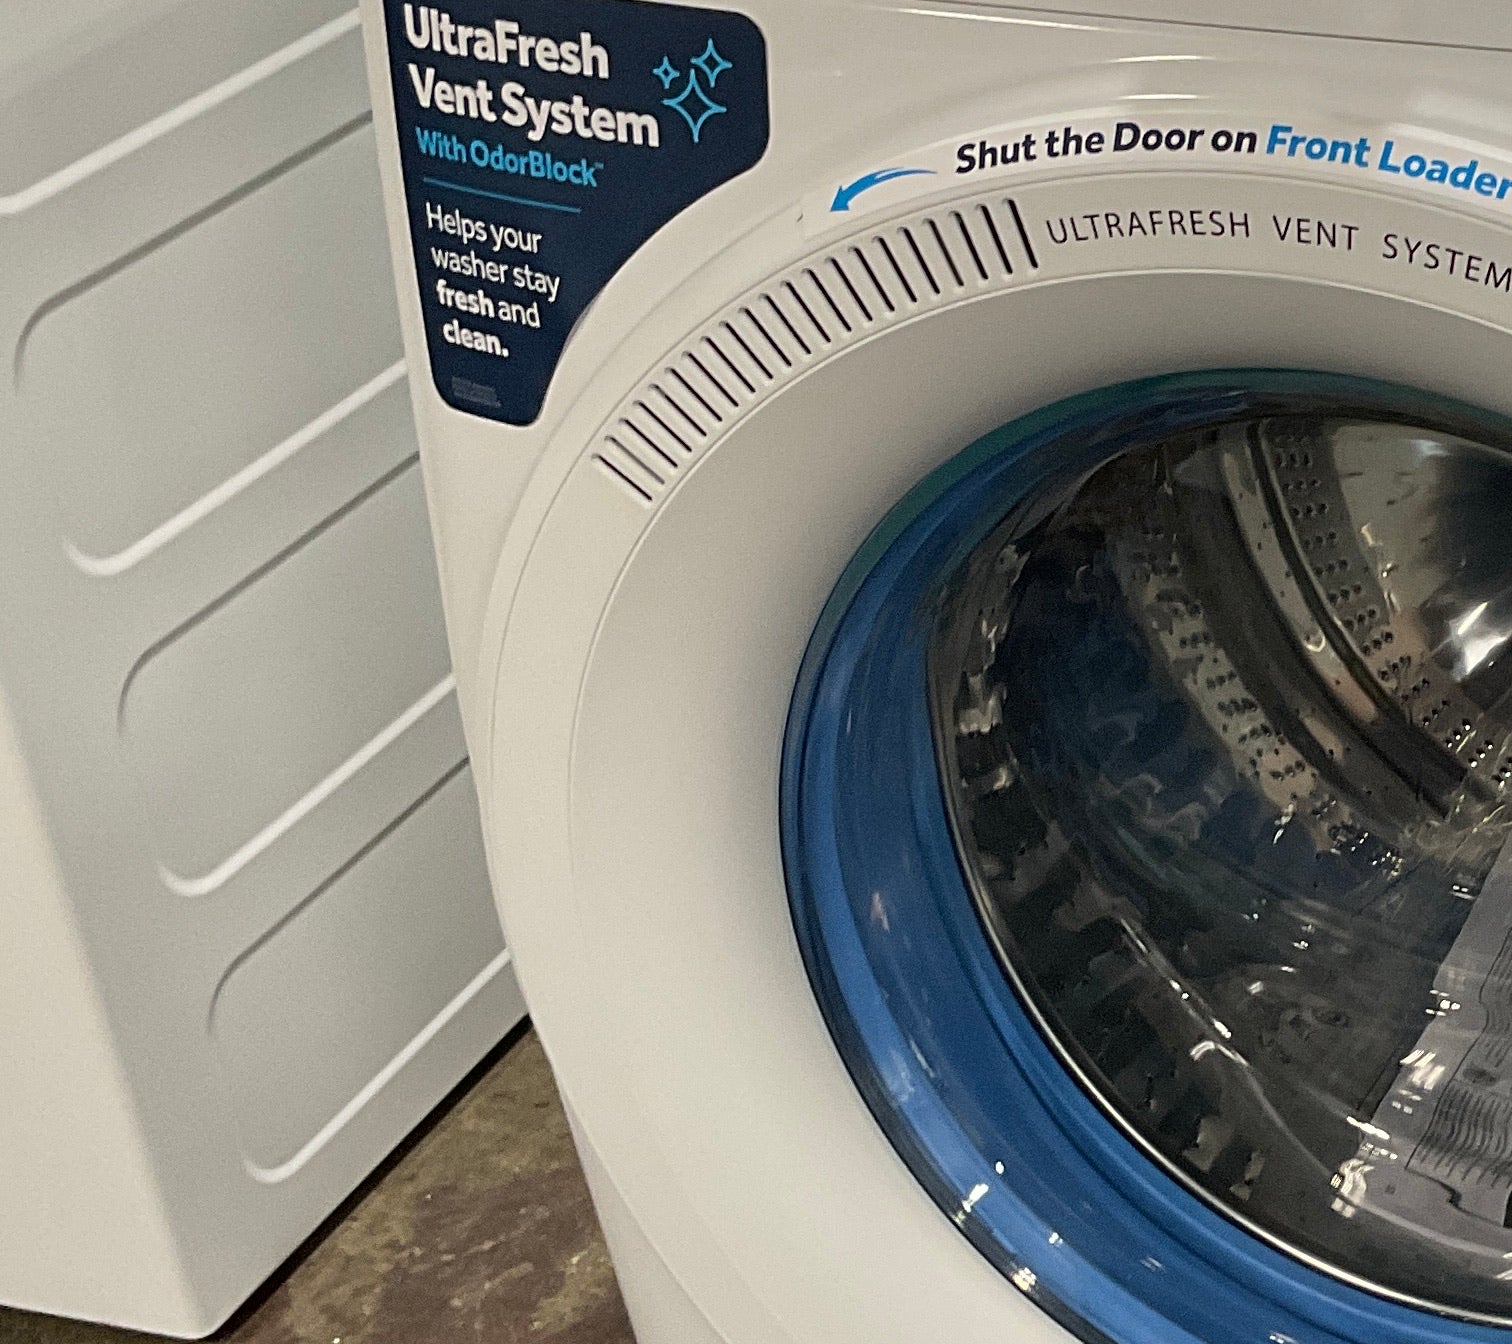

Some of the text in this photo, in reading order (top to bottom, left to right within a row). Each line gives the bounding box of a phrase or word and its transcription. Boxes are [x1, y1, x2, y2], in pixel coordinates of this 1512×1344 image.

[404, 3, 610, 79] UltraFresh
[408, 63, 660, 147] Vent System
[415, 127, 467, 163] With
[955, 134, 1037, 175] Shut
[1045, 126, 1104, 158] the
[1113, 122, 1205, 154] Door
[1211, 126, 1257, 153] on
[1266, 124, 1371, 168] Front
[425, 202, 542, 253] Helps your
[1046, 209, 1512, 293] ULTRAFRESH VENT SYSTEM
[431, 247, 560, 303] washer stay
[435, 279, 541, 328] fresh and
[442, 319, 510, 357] clean.
